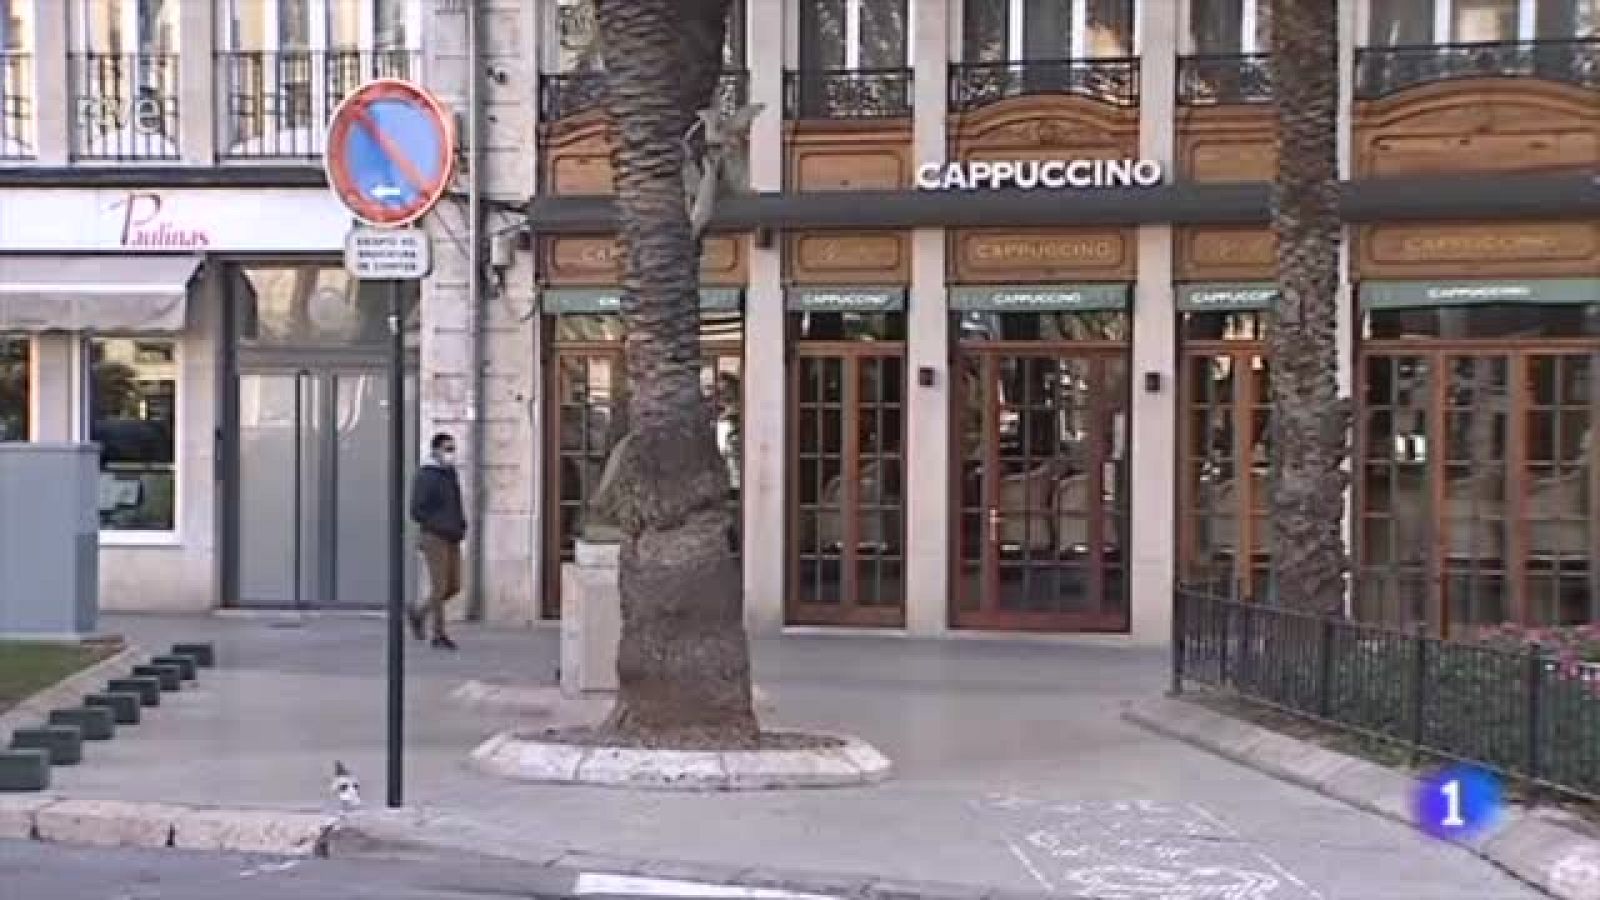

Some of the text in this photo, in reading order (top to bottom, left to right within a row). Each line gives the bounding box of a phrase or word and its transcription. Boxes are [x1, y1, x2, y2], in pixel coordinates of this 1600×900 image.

[917, 159, 1161, 189] CAPPUCCINO
[112, 192, 211, 246] Paulinas
[977, 241, 1112, 260] CAPPUCCINO
